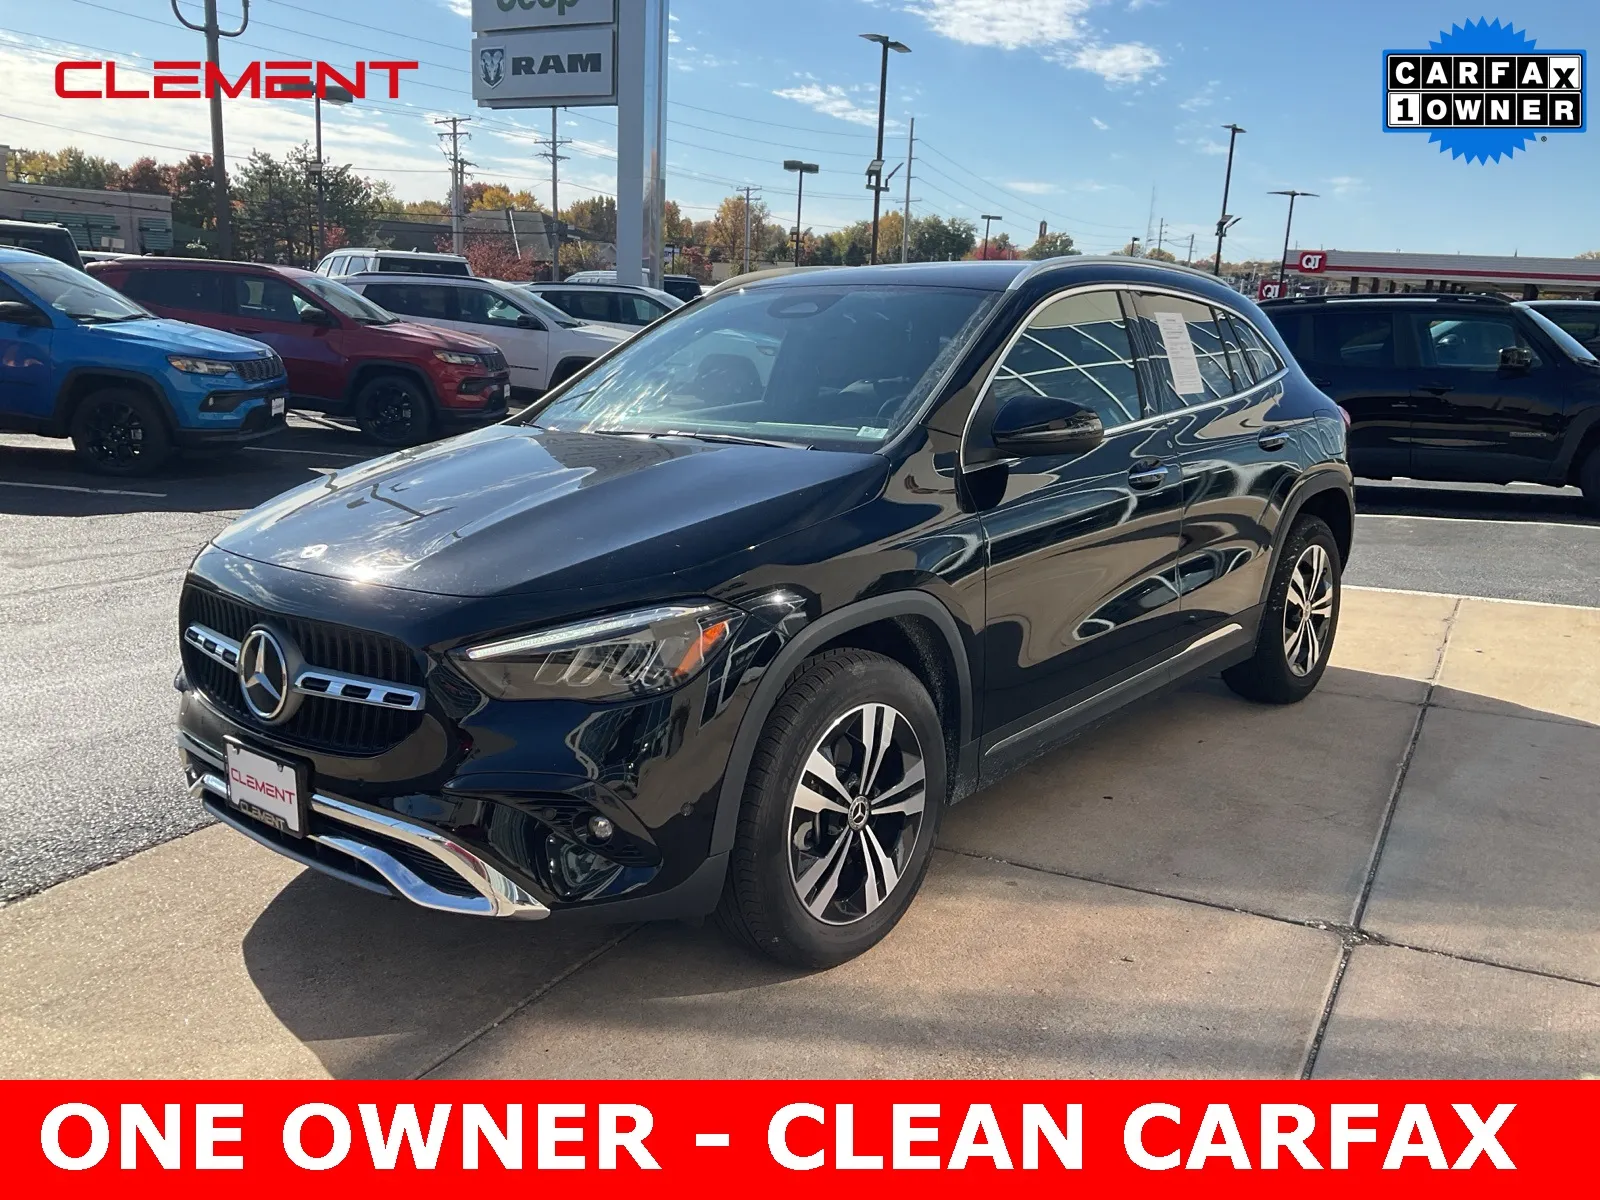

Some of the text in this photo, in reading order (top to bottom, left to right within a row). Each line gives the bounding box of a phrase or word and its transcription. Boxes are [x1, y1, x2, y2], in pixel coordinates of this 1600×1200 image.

[512, 53, 602, 75] RAM
[1302, 254, 1322, 269] QT
[1262, 284, 1280, 299] QT
[231, 767, 295, 804] CLEMENT
[240, 802, 284, 830] CLEMENT
